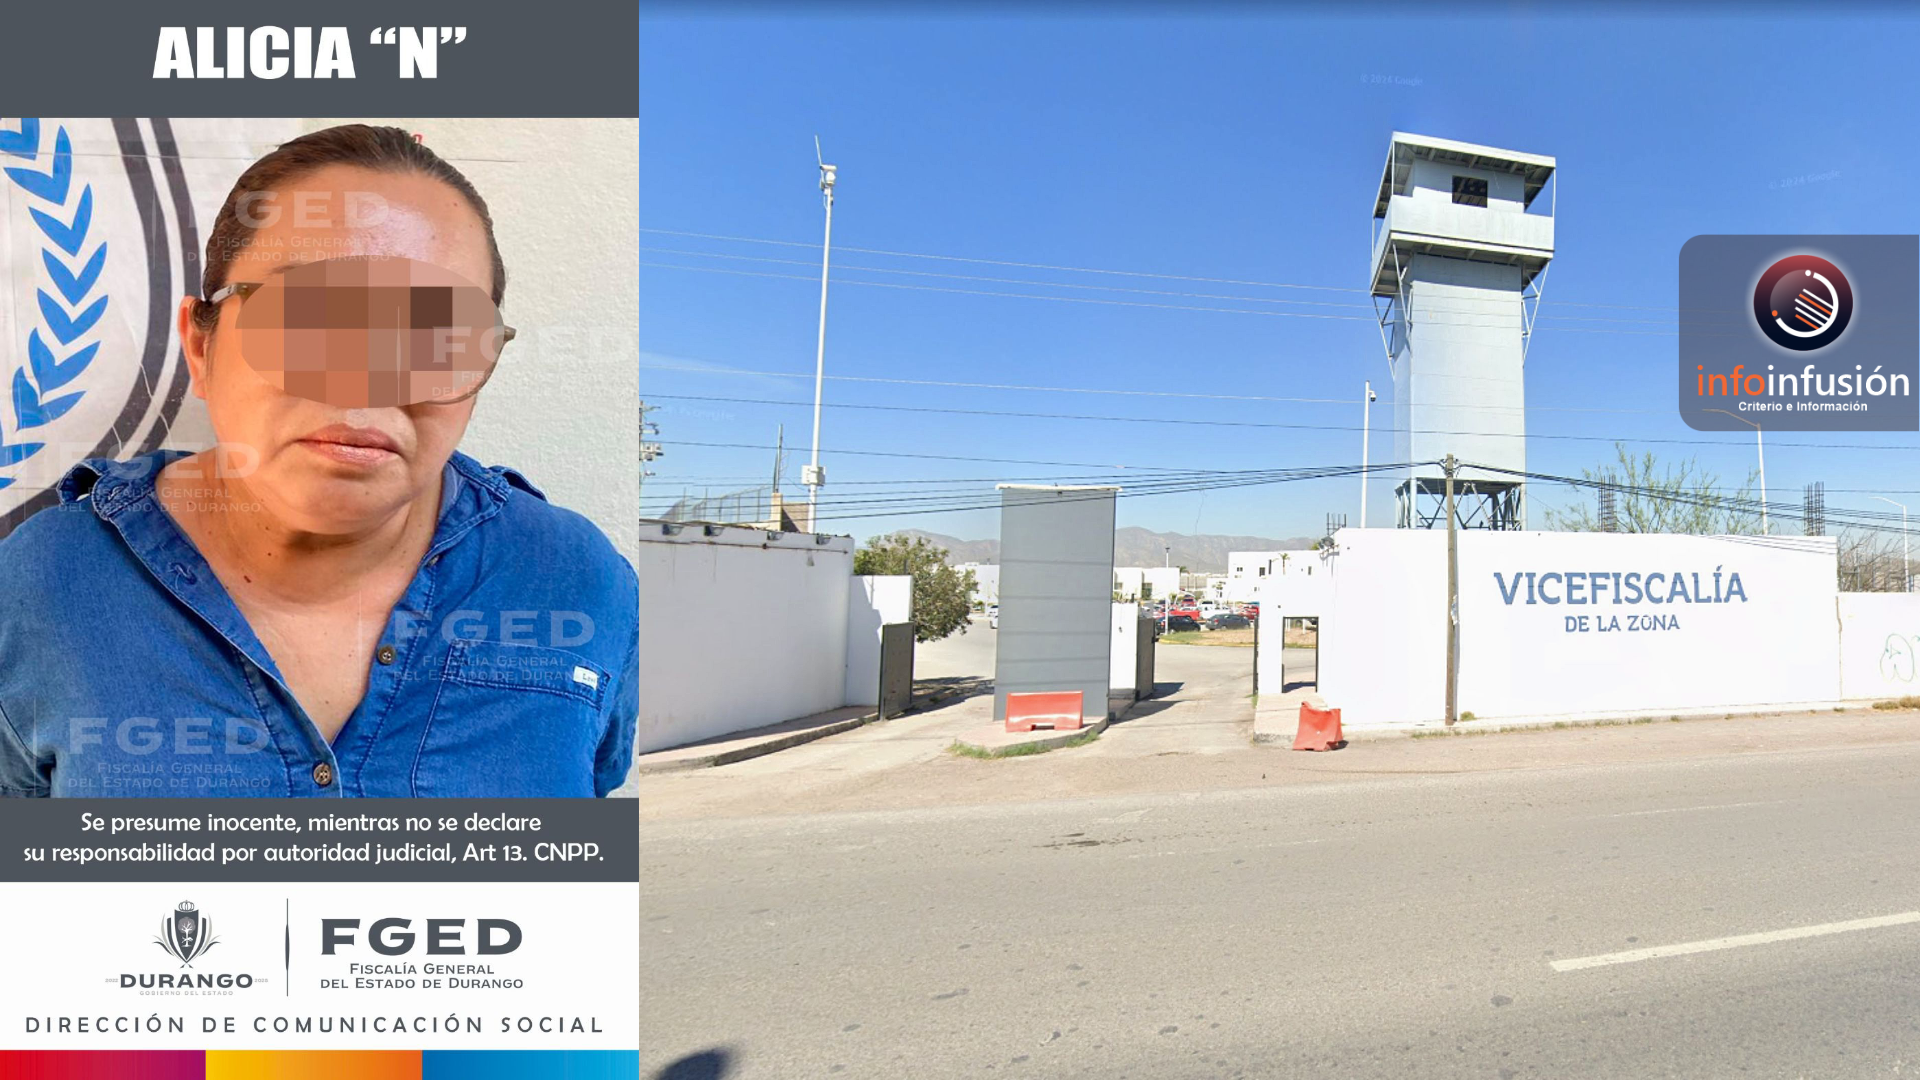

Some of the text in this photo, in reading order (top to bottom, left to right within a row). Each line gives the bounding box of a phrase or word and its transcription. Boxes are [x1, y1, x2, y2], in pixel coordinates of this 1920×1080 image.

[1493, 565, 1748, 605] VICEFISCALÍA
[1564, 614, 1681, 633] DE LA ZONA
